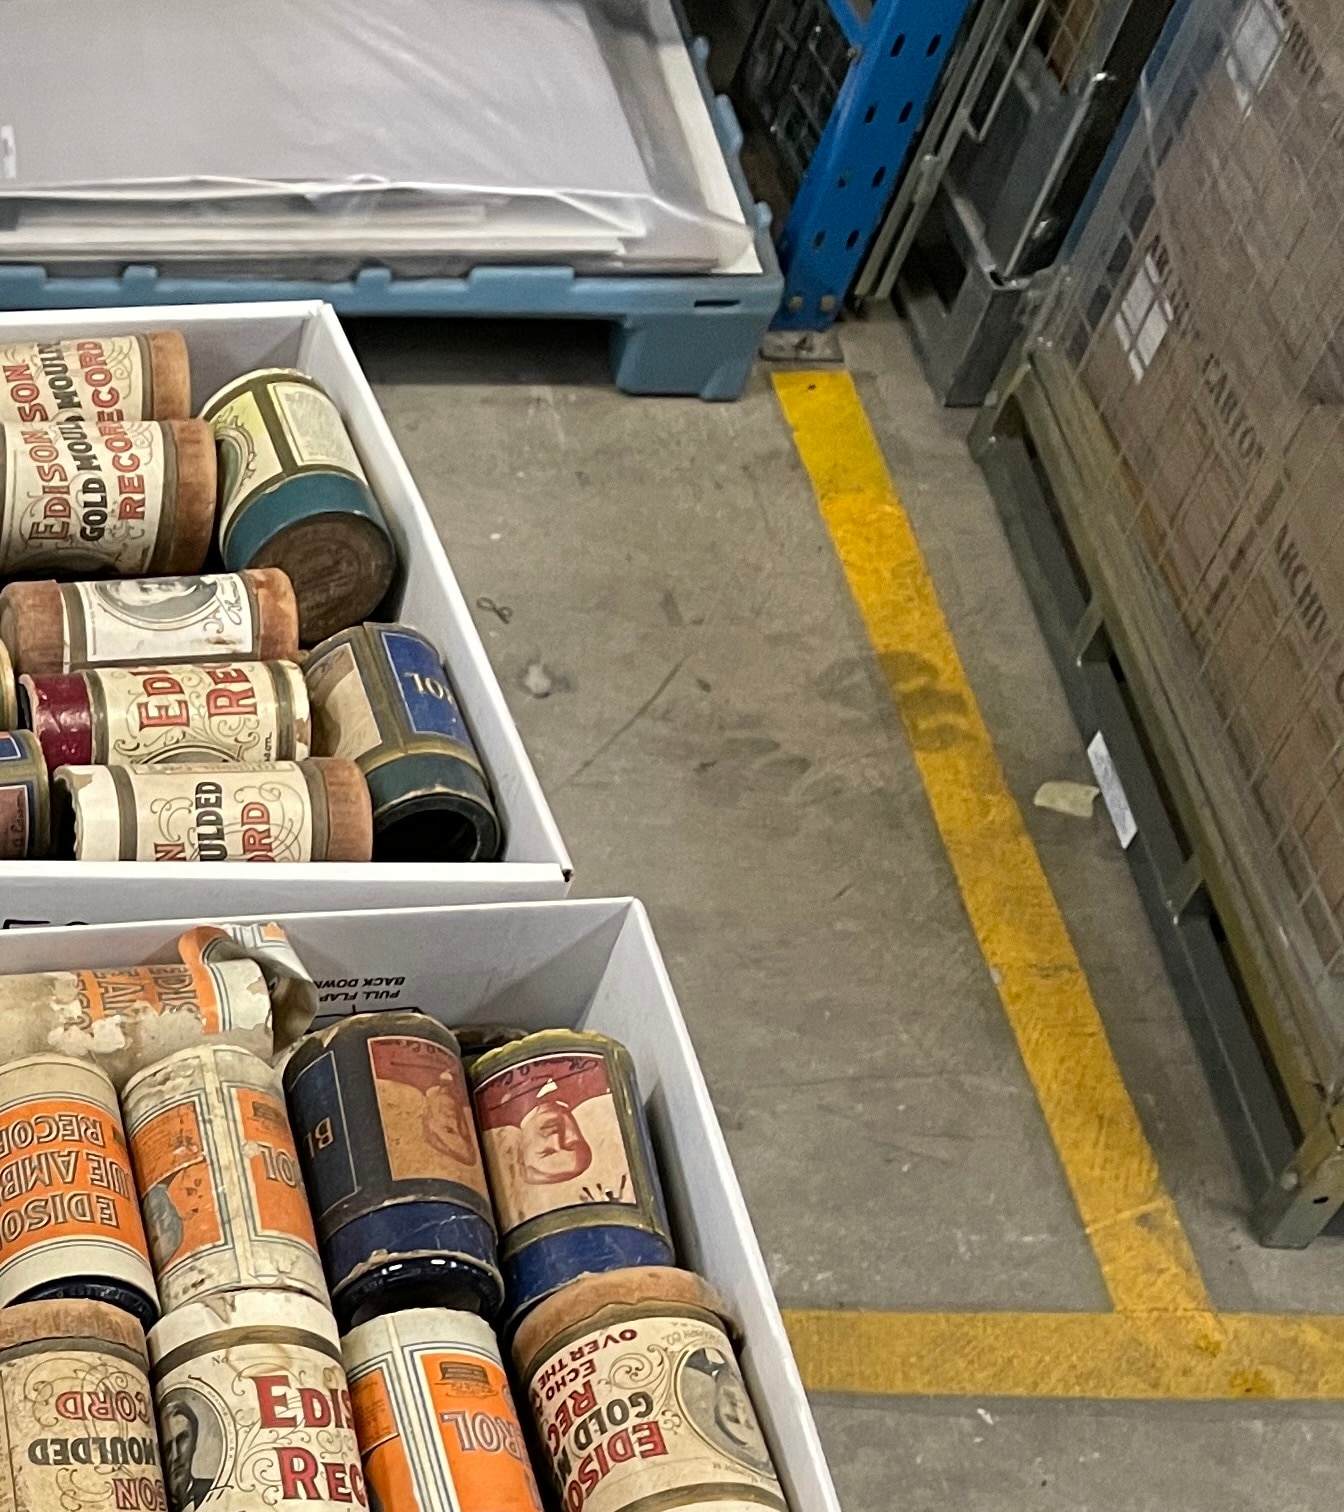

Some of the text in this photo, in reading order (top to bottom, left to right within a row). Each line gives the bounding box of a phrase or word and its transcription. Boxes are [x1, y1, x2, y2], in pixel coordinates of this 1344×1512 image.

[21, 430, 71, 540] EDISON
[80, 478, 107, 541] GOLD
[314, 977, 405, 989] BACK DOWN
[319, 992, 358, 1002] FLAP
[363, 990, 400, 1000] PULL
[538, 1329, 638, 1390] OVER THE
[545, 1358, 597, 1401] ECHO
[573, 1391, 654, 1451] GOLD
